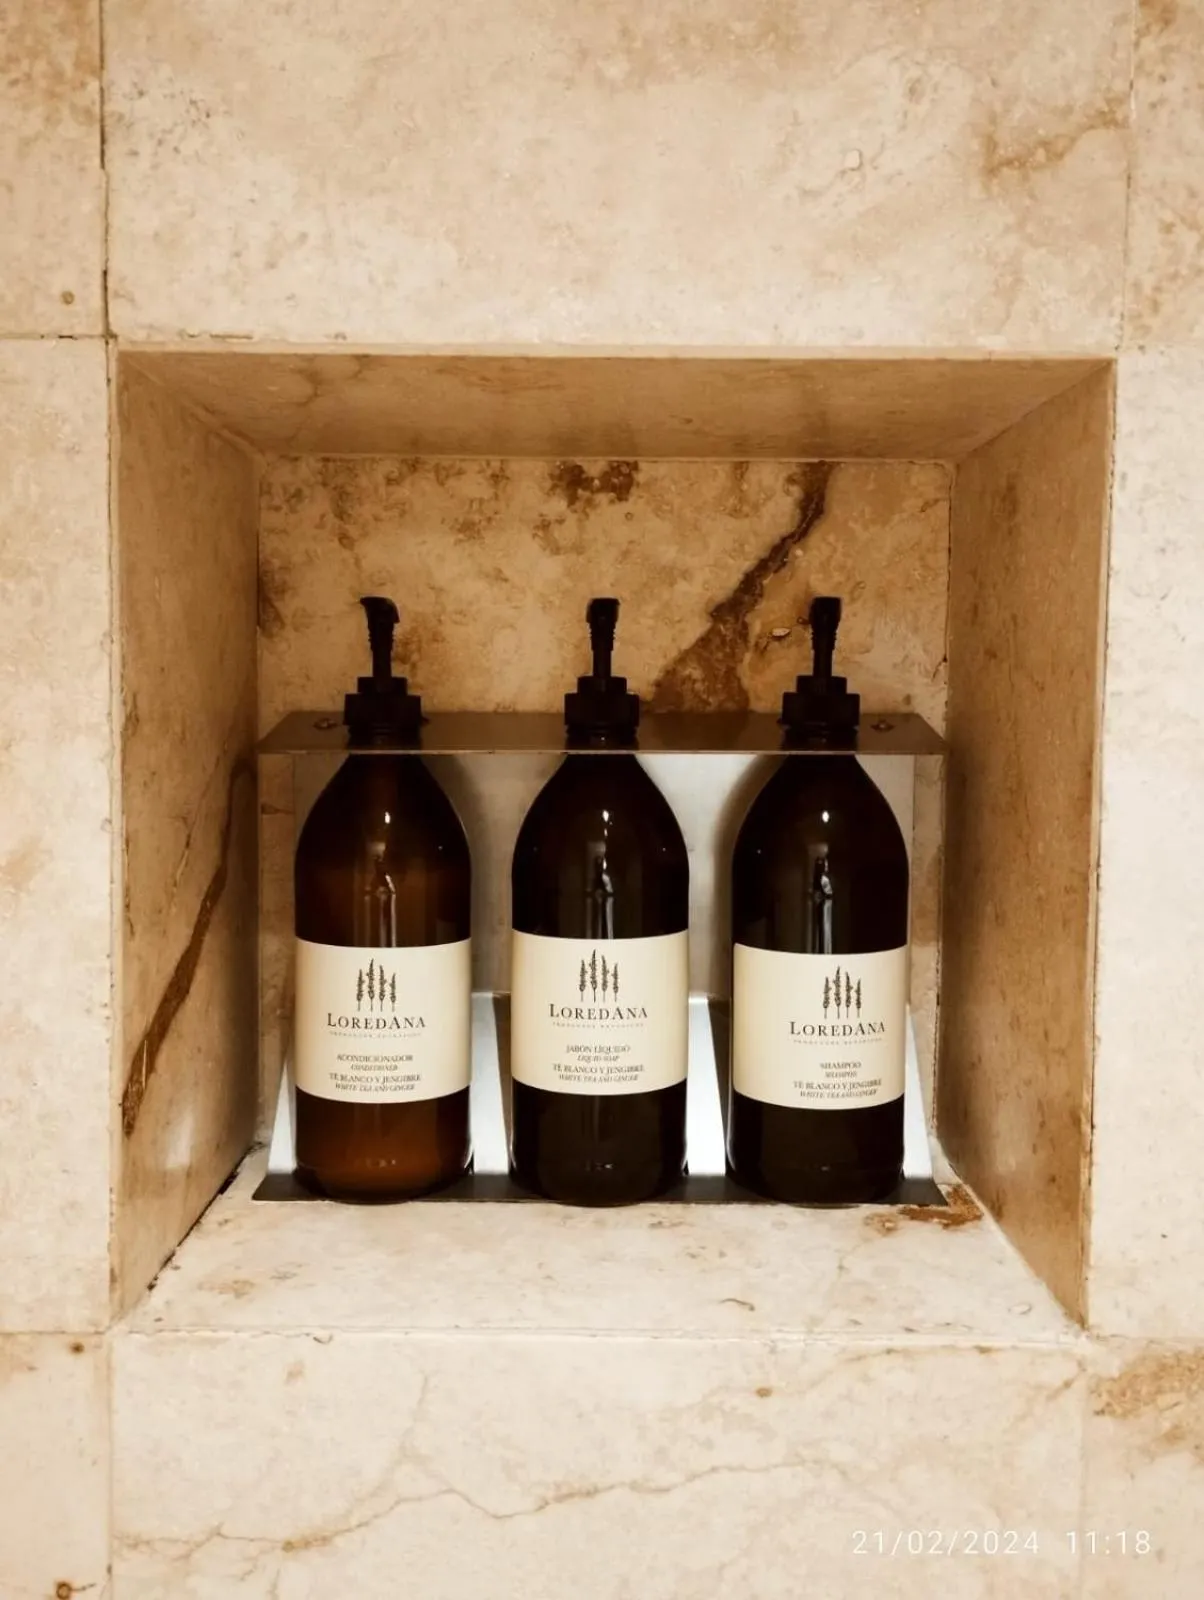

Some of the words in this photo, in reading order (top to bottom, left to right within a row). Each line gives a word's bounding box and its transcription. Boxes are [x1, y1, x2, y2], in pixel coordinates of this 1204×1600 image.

[337, 1054, 413, 1062] ACONDICIONADOR
[563, 1065, 598, 1073] BLANCO
[340, 1074, 374, 1083] BLANCO
